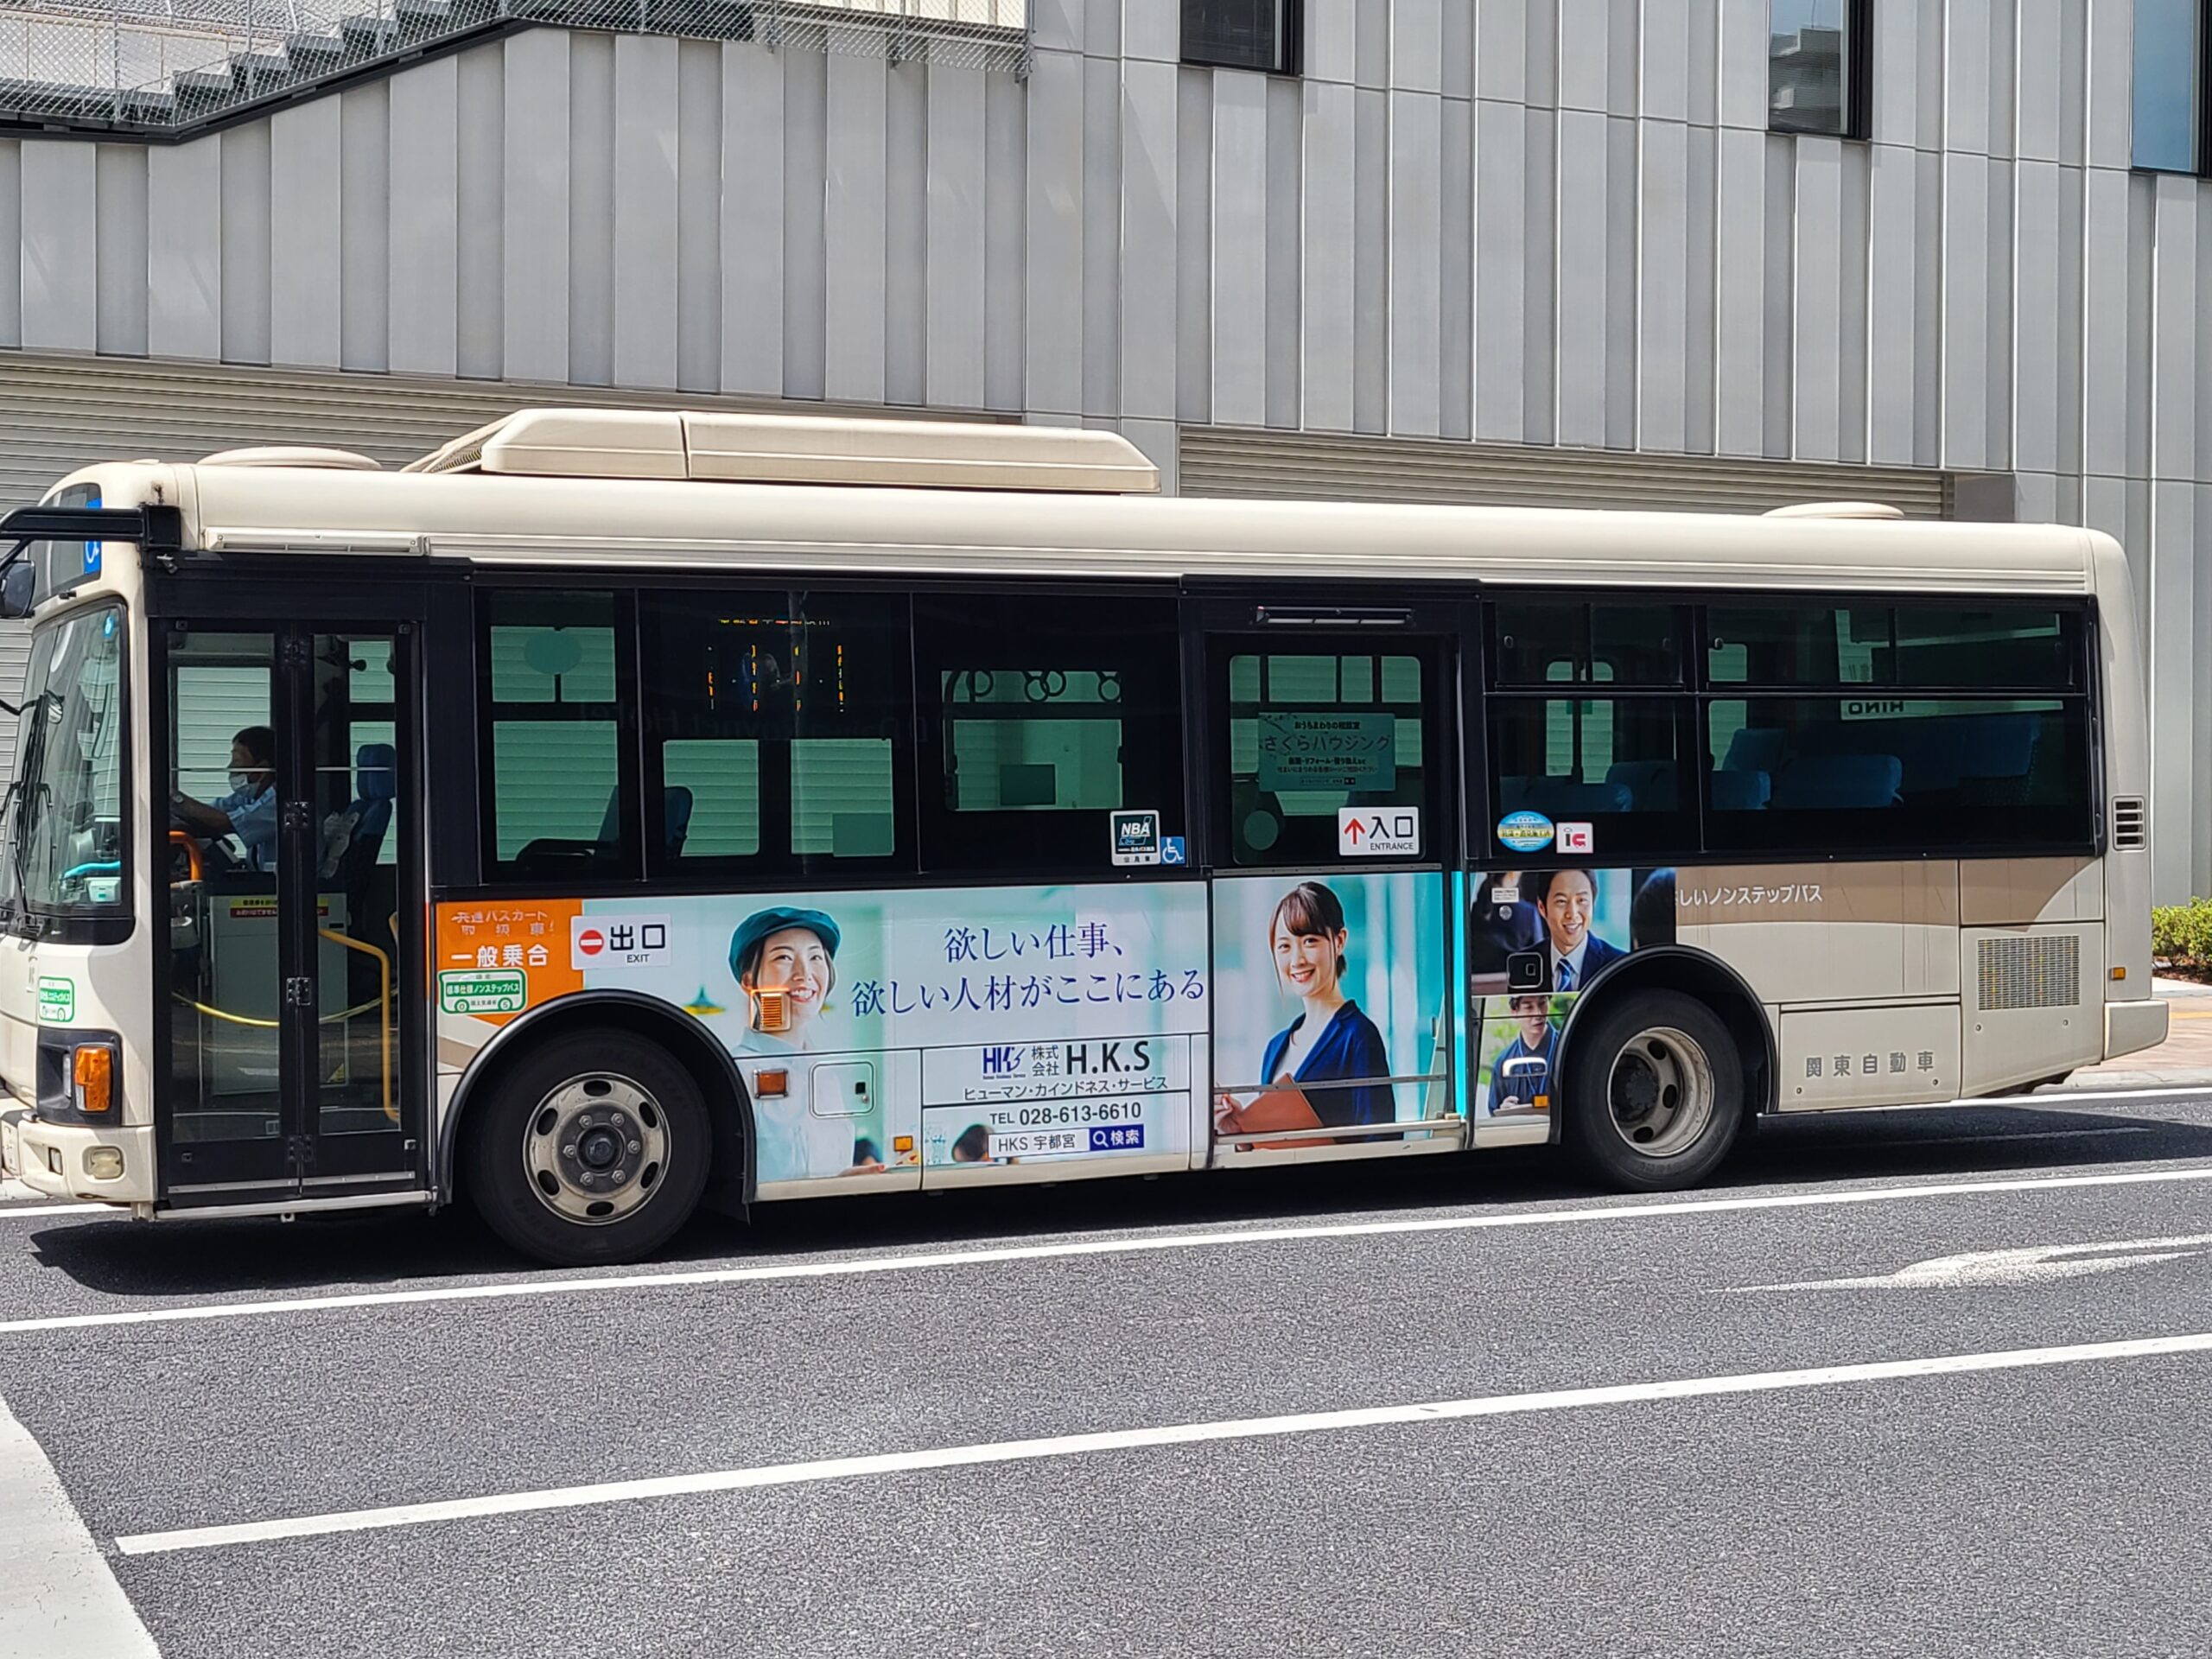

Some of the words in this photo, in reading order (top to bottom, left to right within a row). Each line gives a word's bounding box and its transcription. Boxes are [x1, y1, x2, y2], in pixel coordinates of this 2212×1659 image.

[1264, 734, 1390, 752] さくらハウジング
[1121, 822, 1152, 836] NBA
[1369, 816, 1414, 839] 入口
[1370, 842, 1414, 851] ENTRANCE
[1675, 884, 1823, 907] しいノンステップバス
[609, 924, 666, 951] 出口
[944, 921, 1124, 963] 欲しい仕事、
[450, 944, 549, 968] 一般乗合
[626, 953, 650, 963] EXIT
[849, 968, 1205, 1018] 欲しい人材がここにある
[1031, 1044, 1059, 1061] 株式
[1065, 1039, 1151, 1076] H.K.S
[1806, 1050, 1935, 1078] 関東自動車
[1031, 1060, 1060, 1077] 会社
[964, 1076, 1168, 1102] ヒューマン・カインドネス・サービス
[989, 1112, 1015, 1126] TEL
[1019, 1102, 1141, 1126] 028-613-6610
[998, 1136, 1028, 1153] HKS
[1033, 1133, 1076, 1151] 宇都宮
[1110, 1129, 1139, 1146] 検索
